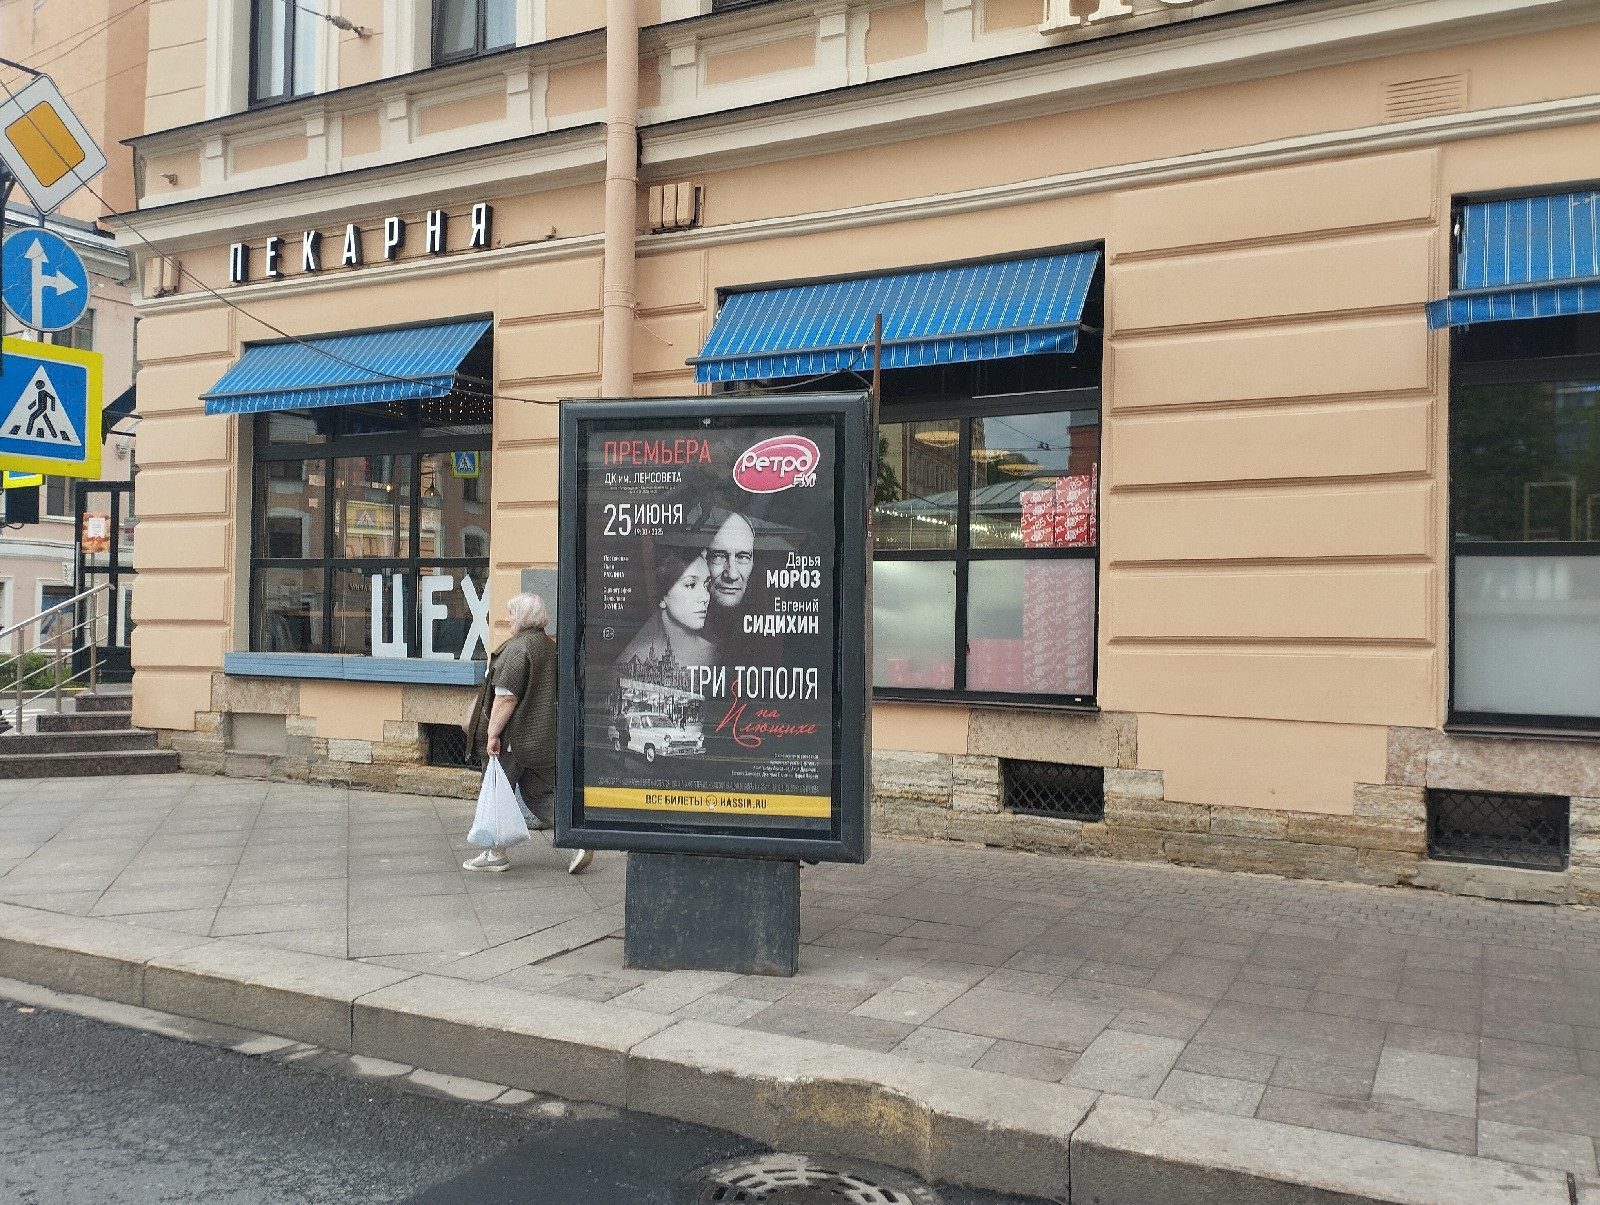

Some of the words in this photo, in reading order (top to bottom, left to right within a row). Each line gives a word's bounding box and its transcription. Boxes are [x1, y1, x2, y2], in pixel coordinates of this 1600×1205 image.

[229, 202, 489, 283] ПЕКАРНЯ
[604, 439, 711, 465] ПРЕМЬЕРА
[633, 471, 682, 484] ЛЕНСОВЕТА
[603, 503, 632, 536] 25
[634, 503, 683, 525] ИЮНЯ
[785, 551, 821, 571] Дарья
[766, 569, 821, 589] МОРОЗ
[774, 596, 819, 613] Евгений
[371, 573, 490, 660] ЦЕХ
[743, 614, 819, 637] СИДИХИН
[686, 665, 726, 700] ТРИ
[734, 665, 818, 700] ТОПОЛЯ
[645, 794, 663, 804] ВСЕ
[664, 794, 703, 806] БИЛЕТЫ
